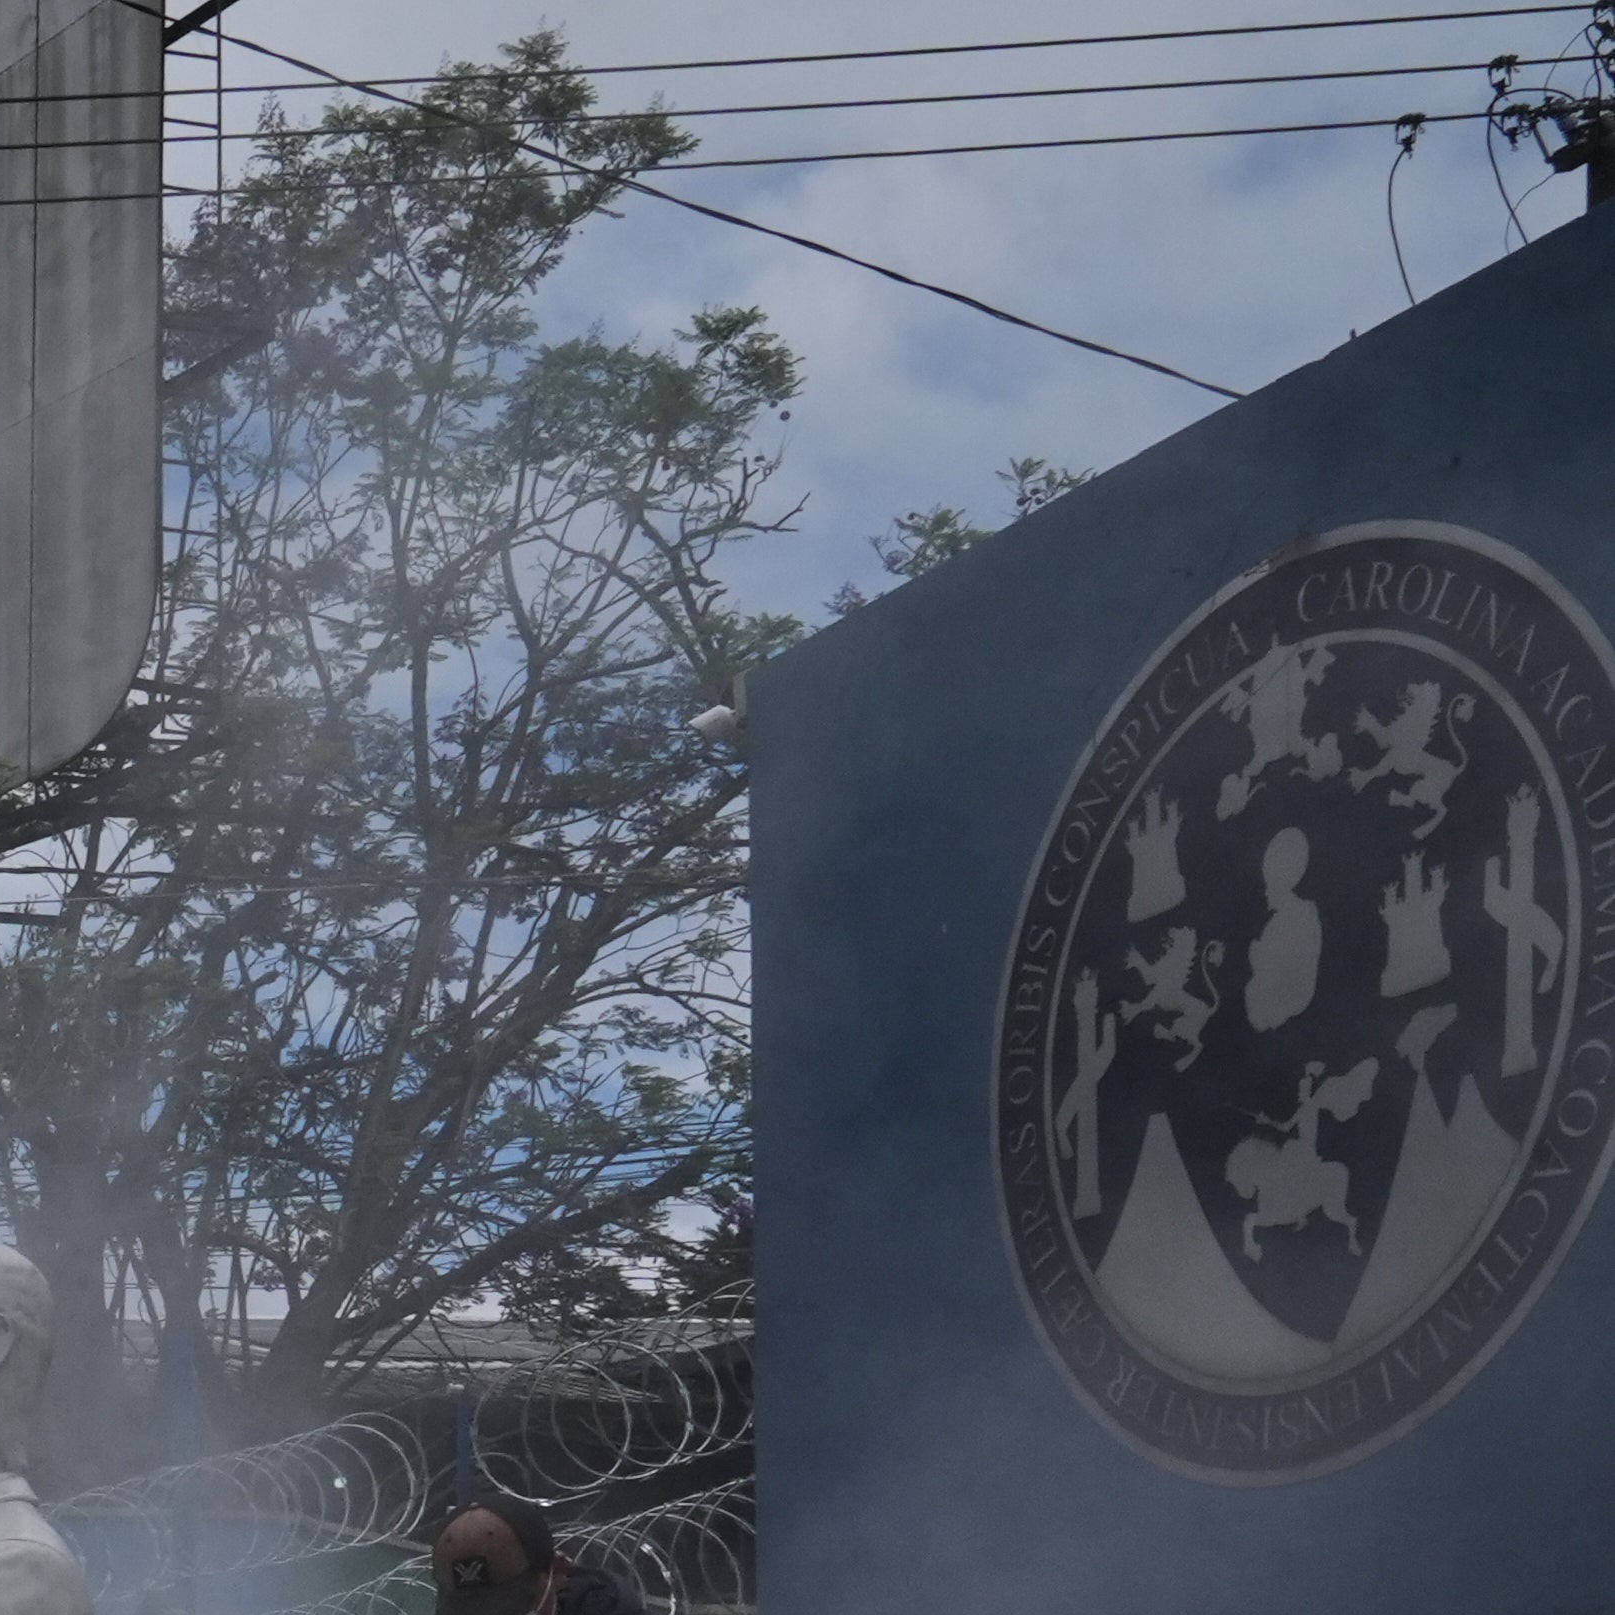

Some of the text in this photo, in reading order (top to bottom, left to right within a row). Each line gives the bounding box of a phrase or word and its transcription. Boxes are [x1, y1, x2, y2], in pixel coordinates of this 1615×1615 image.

[1295, 560, 1537, 678] CAROLINA
[1044, 620, 1250, 907] CONSPICUA
[1007, 923, 1057, 1106] ORBIS
